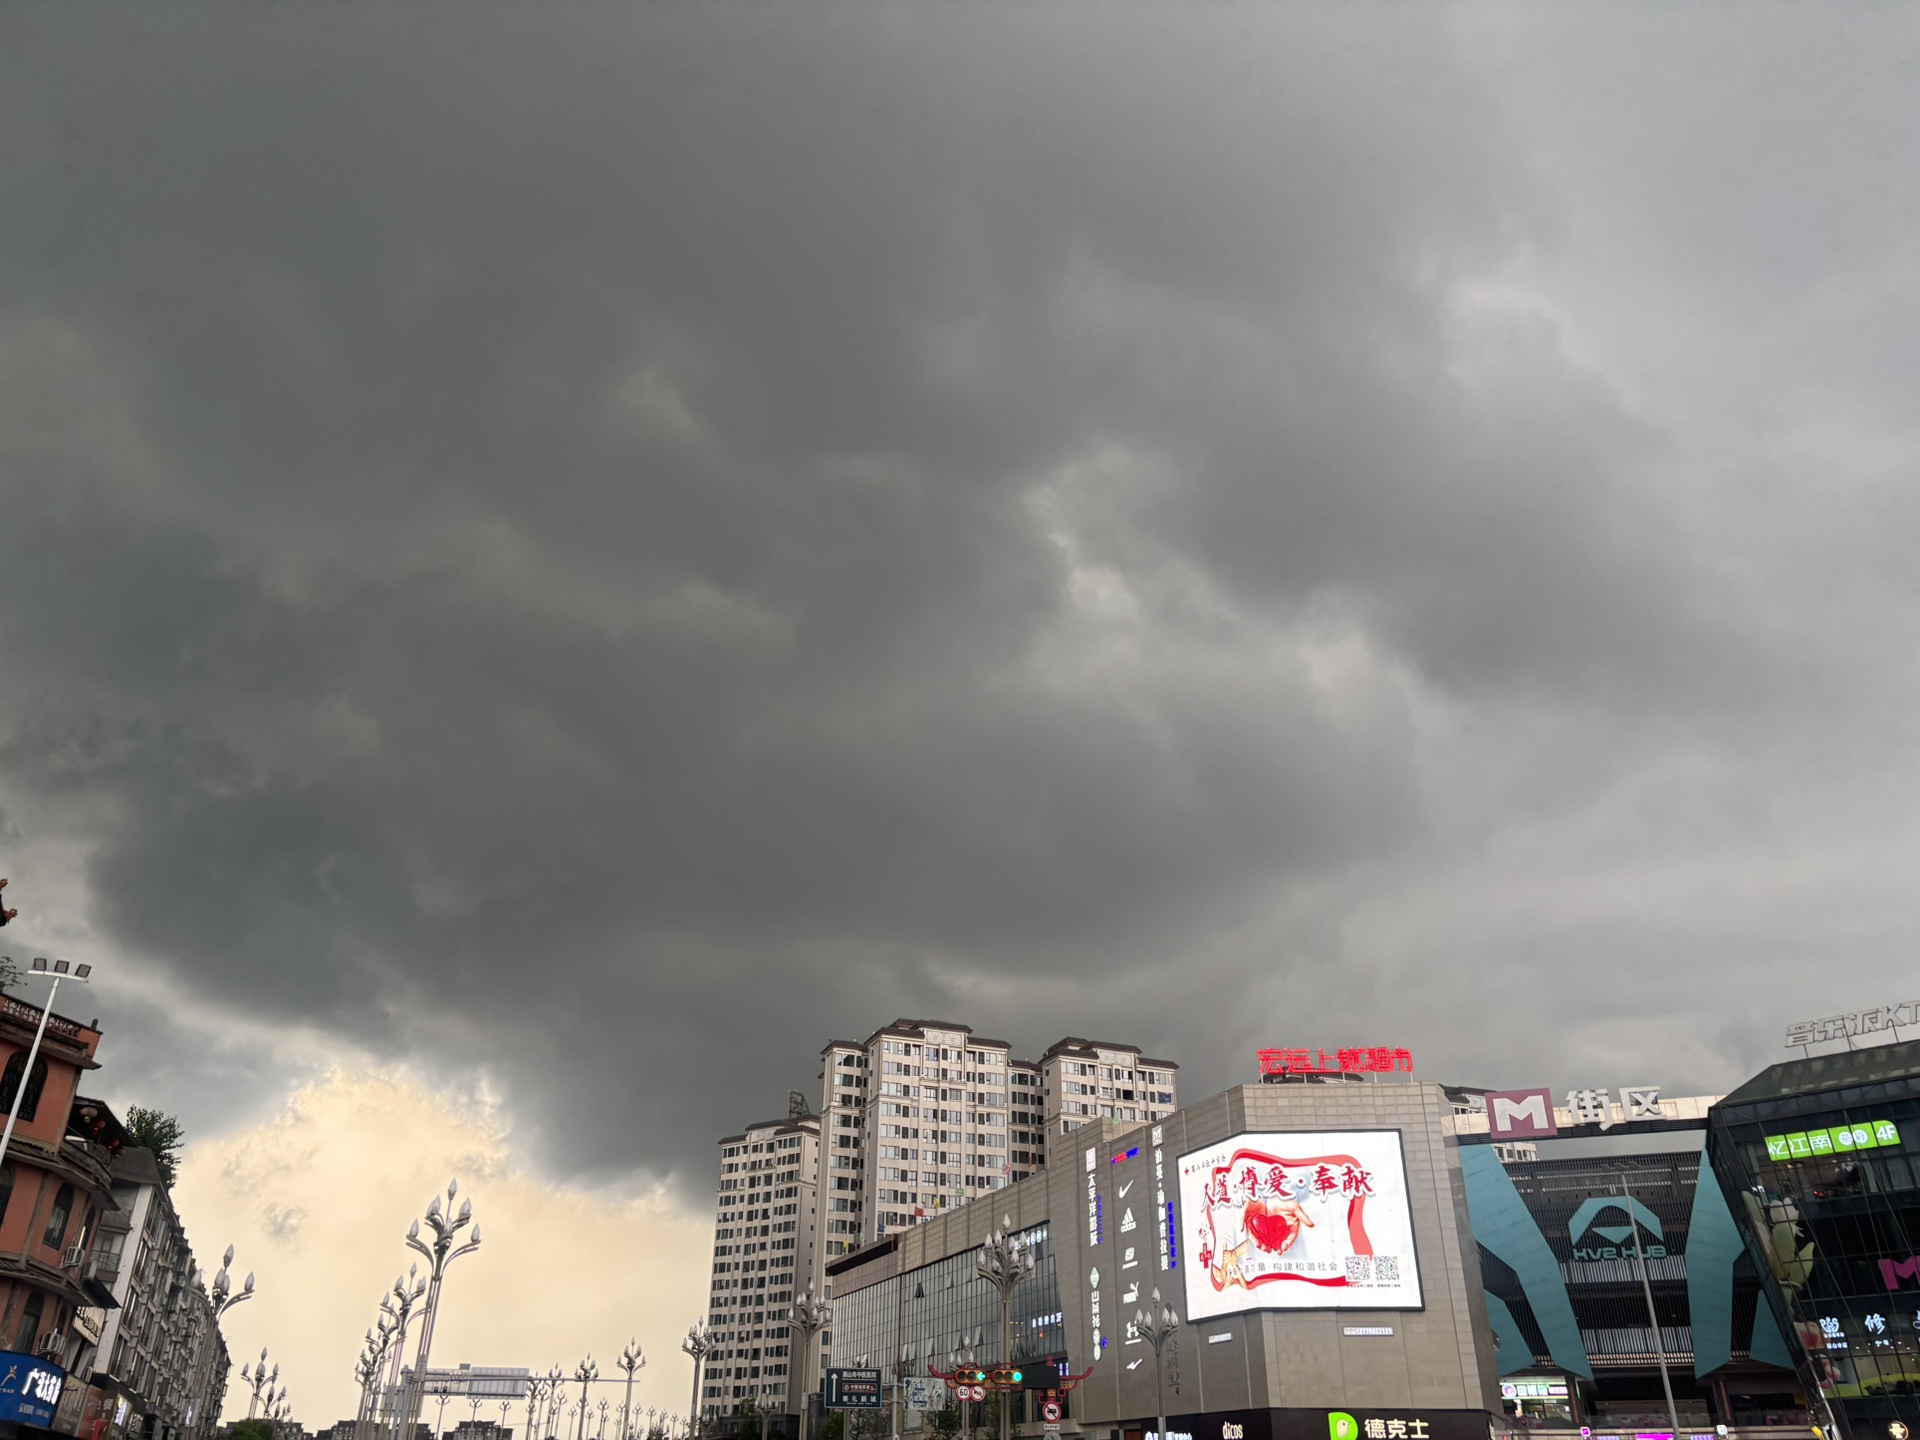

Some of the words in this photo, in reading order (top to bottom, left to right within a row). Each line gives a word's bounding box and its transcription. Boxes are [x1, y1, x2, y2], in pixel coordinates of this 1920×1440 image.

[1565, 1086, 1667, 1131] 街区
[1768, 1134, 1832, 1156] 忆江南
[1877, 1125, 1896, 1141] 4F
[959, 1388, 968, 1397] 60
[1222, 1421, 1243, 1440] dicos
[1364, 1418, 1429, 1439] 德克士
